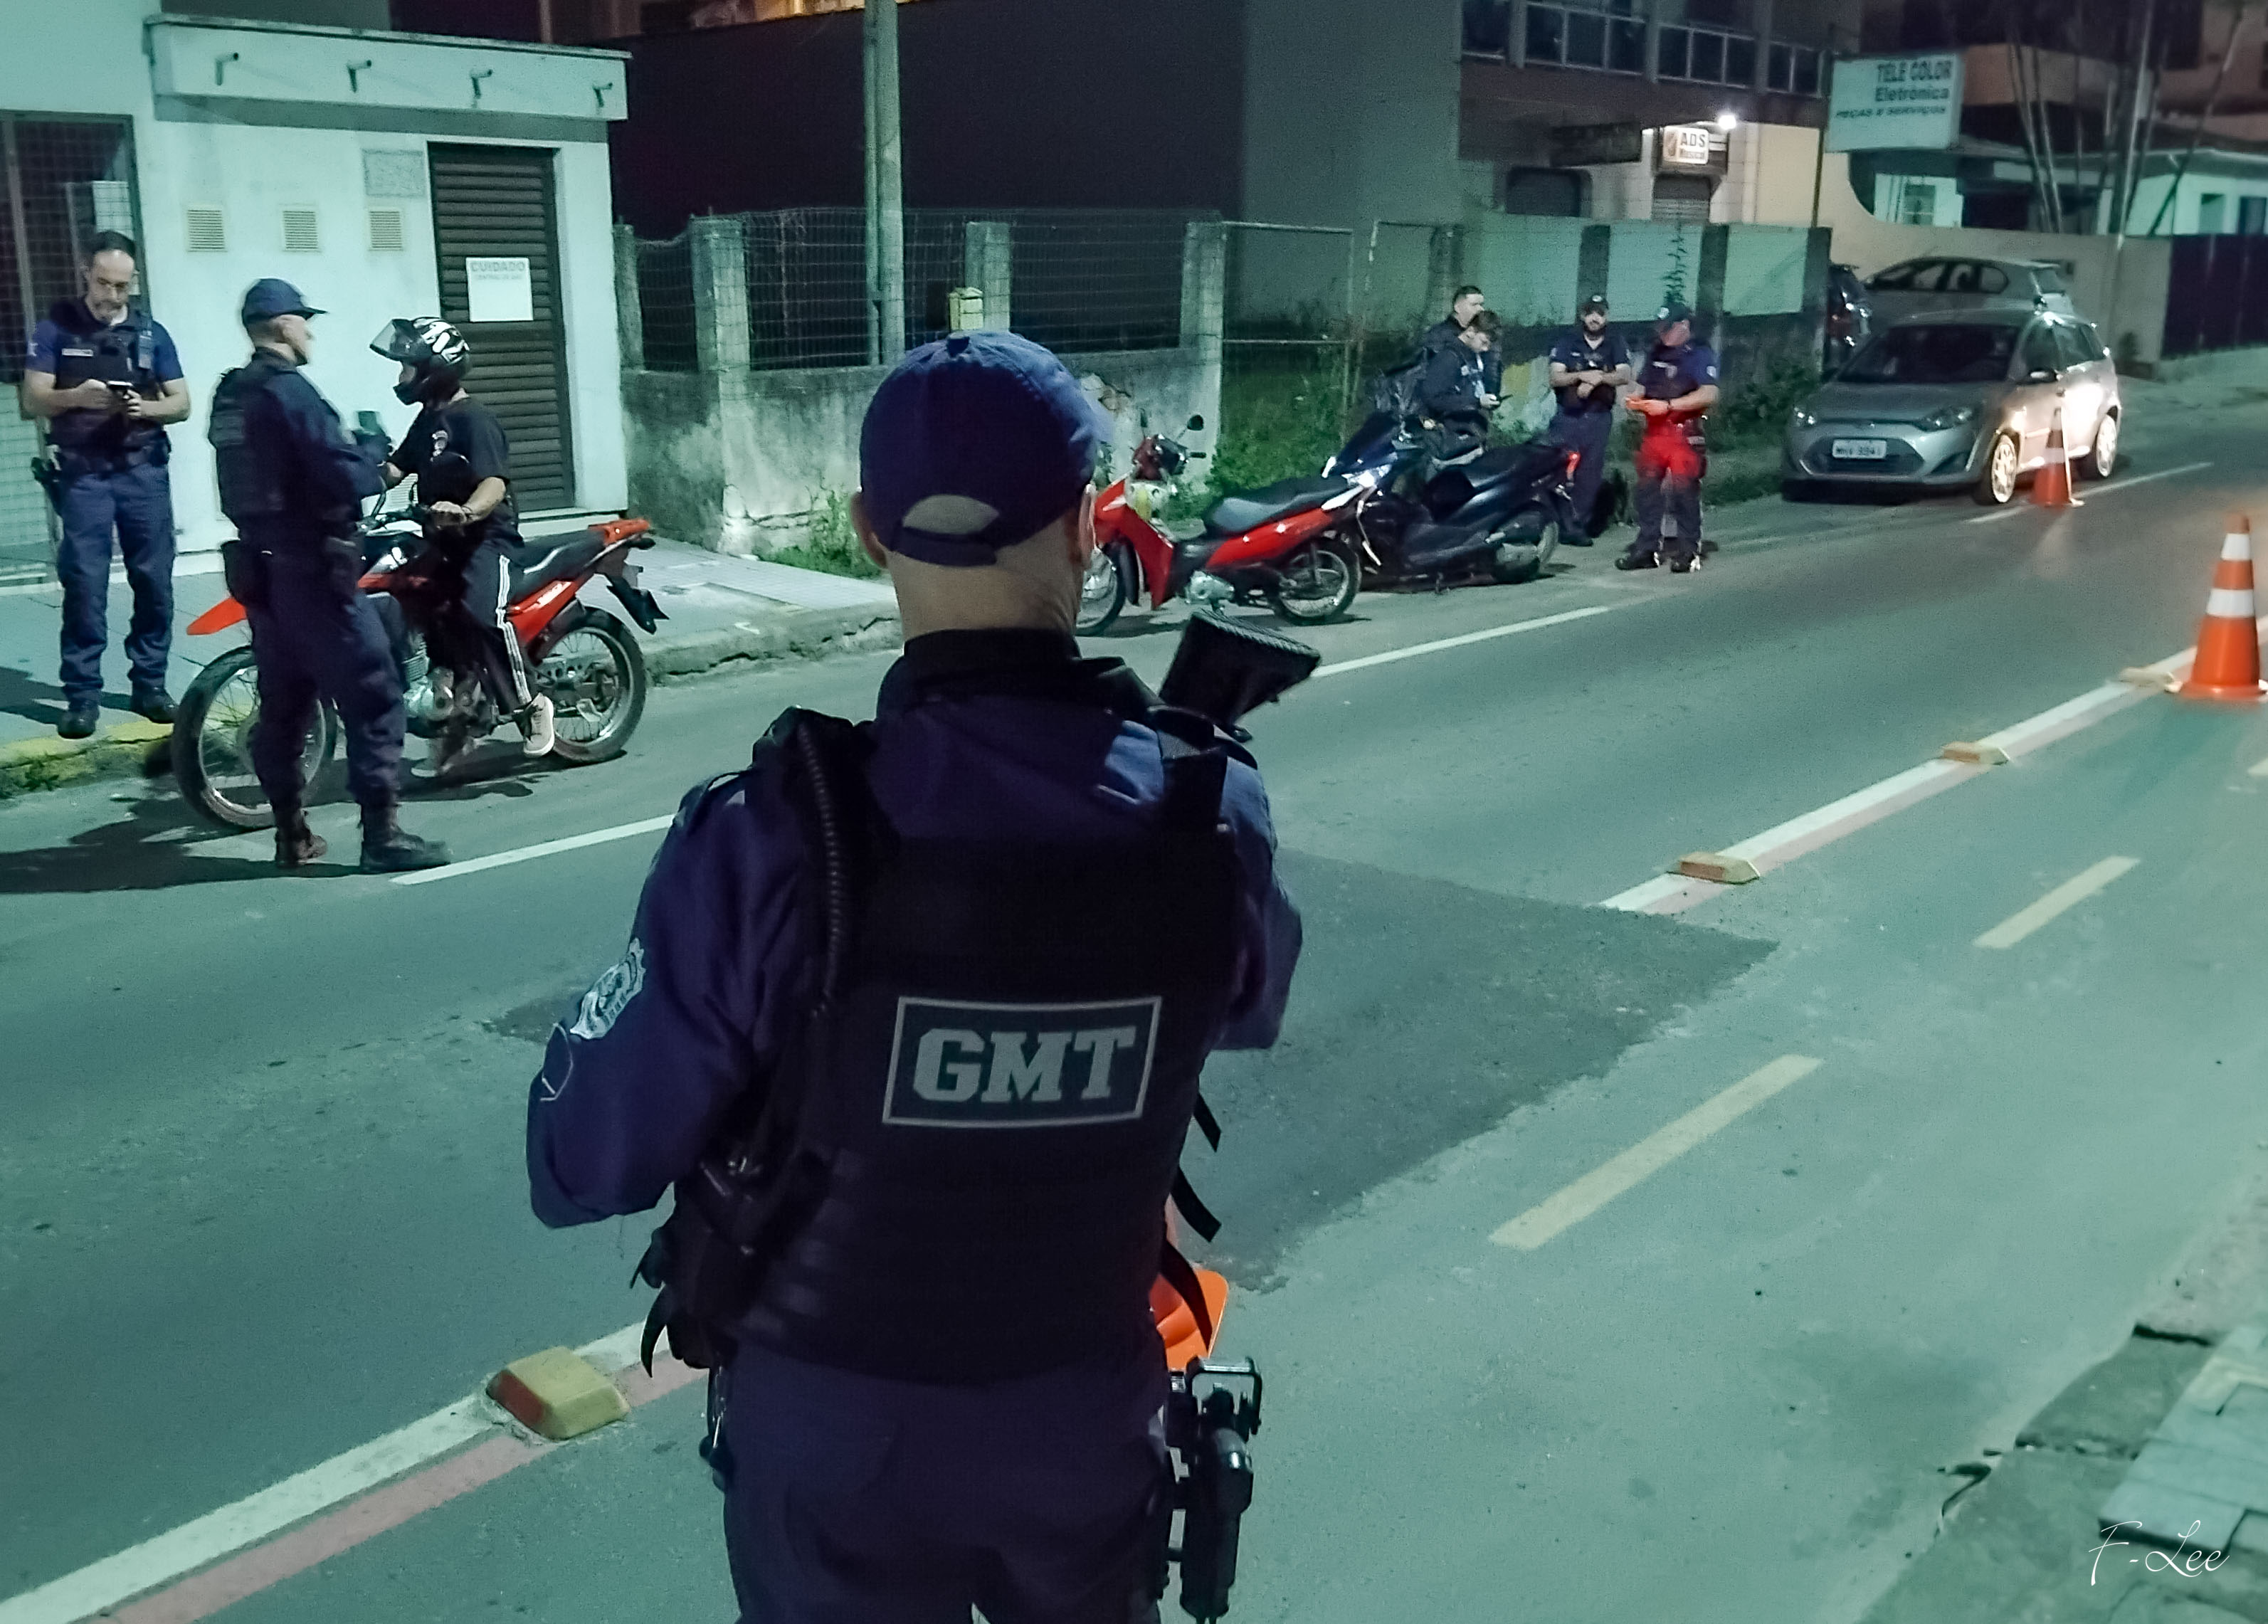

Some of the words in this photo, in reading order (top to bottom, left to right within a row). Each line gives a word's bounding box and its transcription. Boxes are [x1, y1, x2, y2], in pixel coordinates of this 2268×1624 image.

[1910, 59, 1952, 82] COLOR
[1679, 132, 1706, 147] ADS
[470, 261, 526, 272] CUIDADO
[912, 1025, 1137, 1104] GMT
